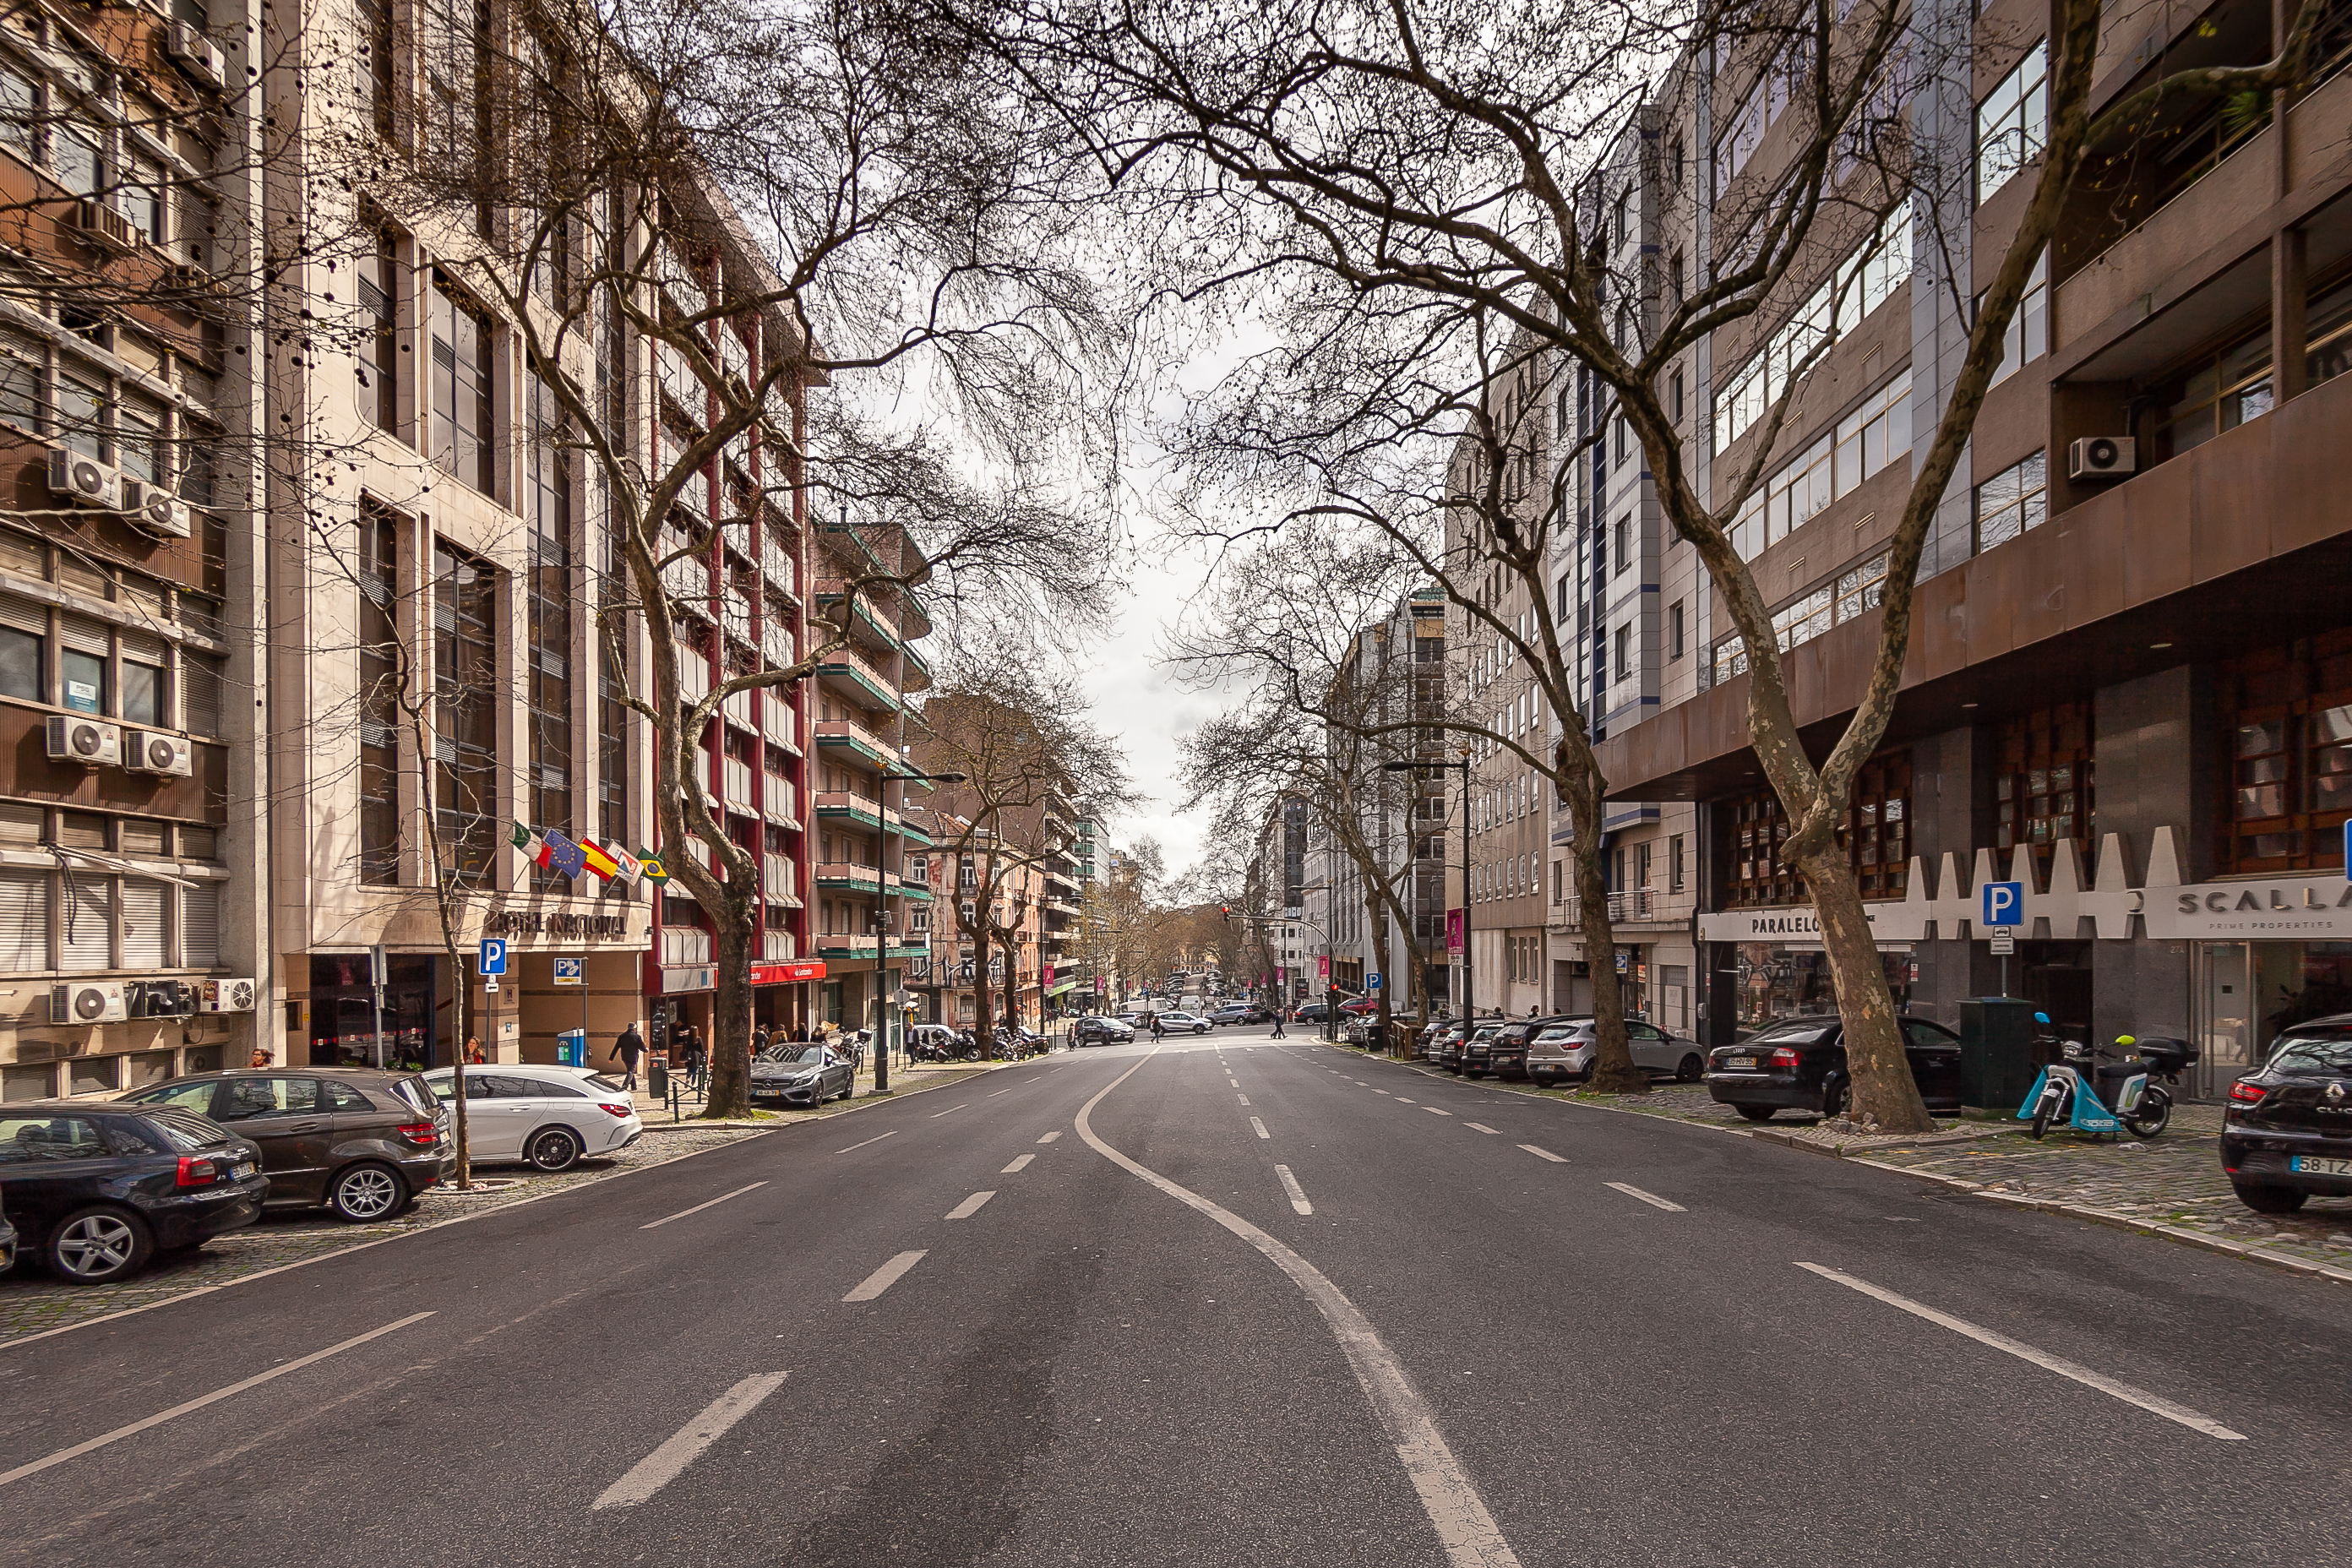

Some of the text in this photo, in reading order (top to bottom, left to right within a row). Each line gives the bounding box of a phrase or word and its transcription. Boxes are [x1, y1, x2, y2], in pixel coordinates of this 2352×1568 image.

[1991, 886, 2013, 922] P
[2251, 921, 2333, 929] PROPERTIES
[485, 942, 501, 971] P
[558, 961, 567, 972] P
[1369, 974, 1378, 987] P
